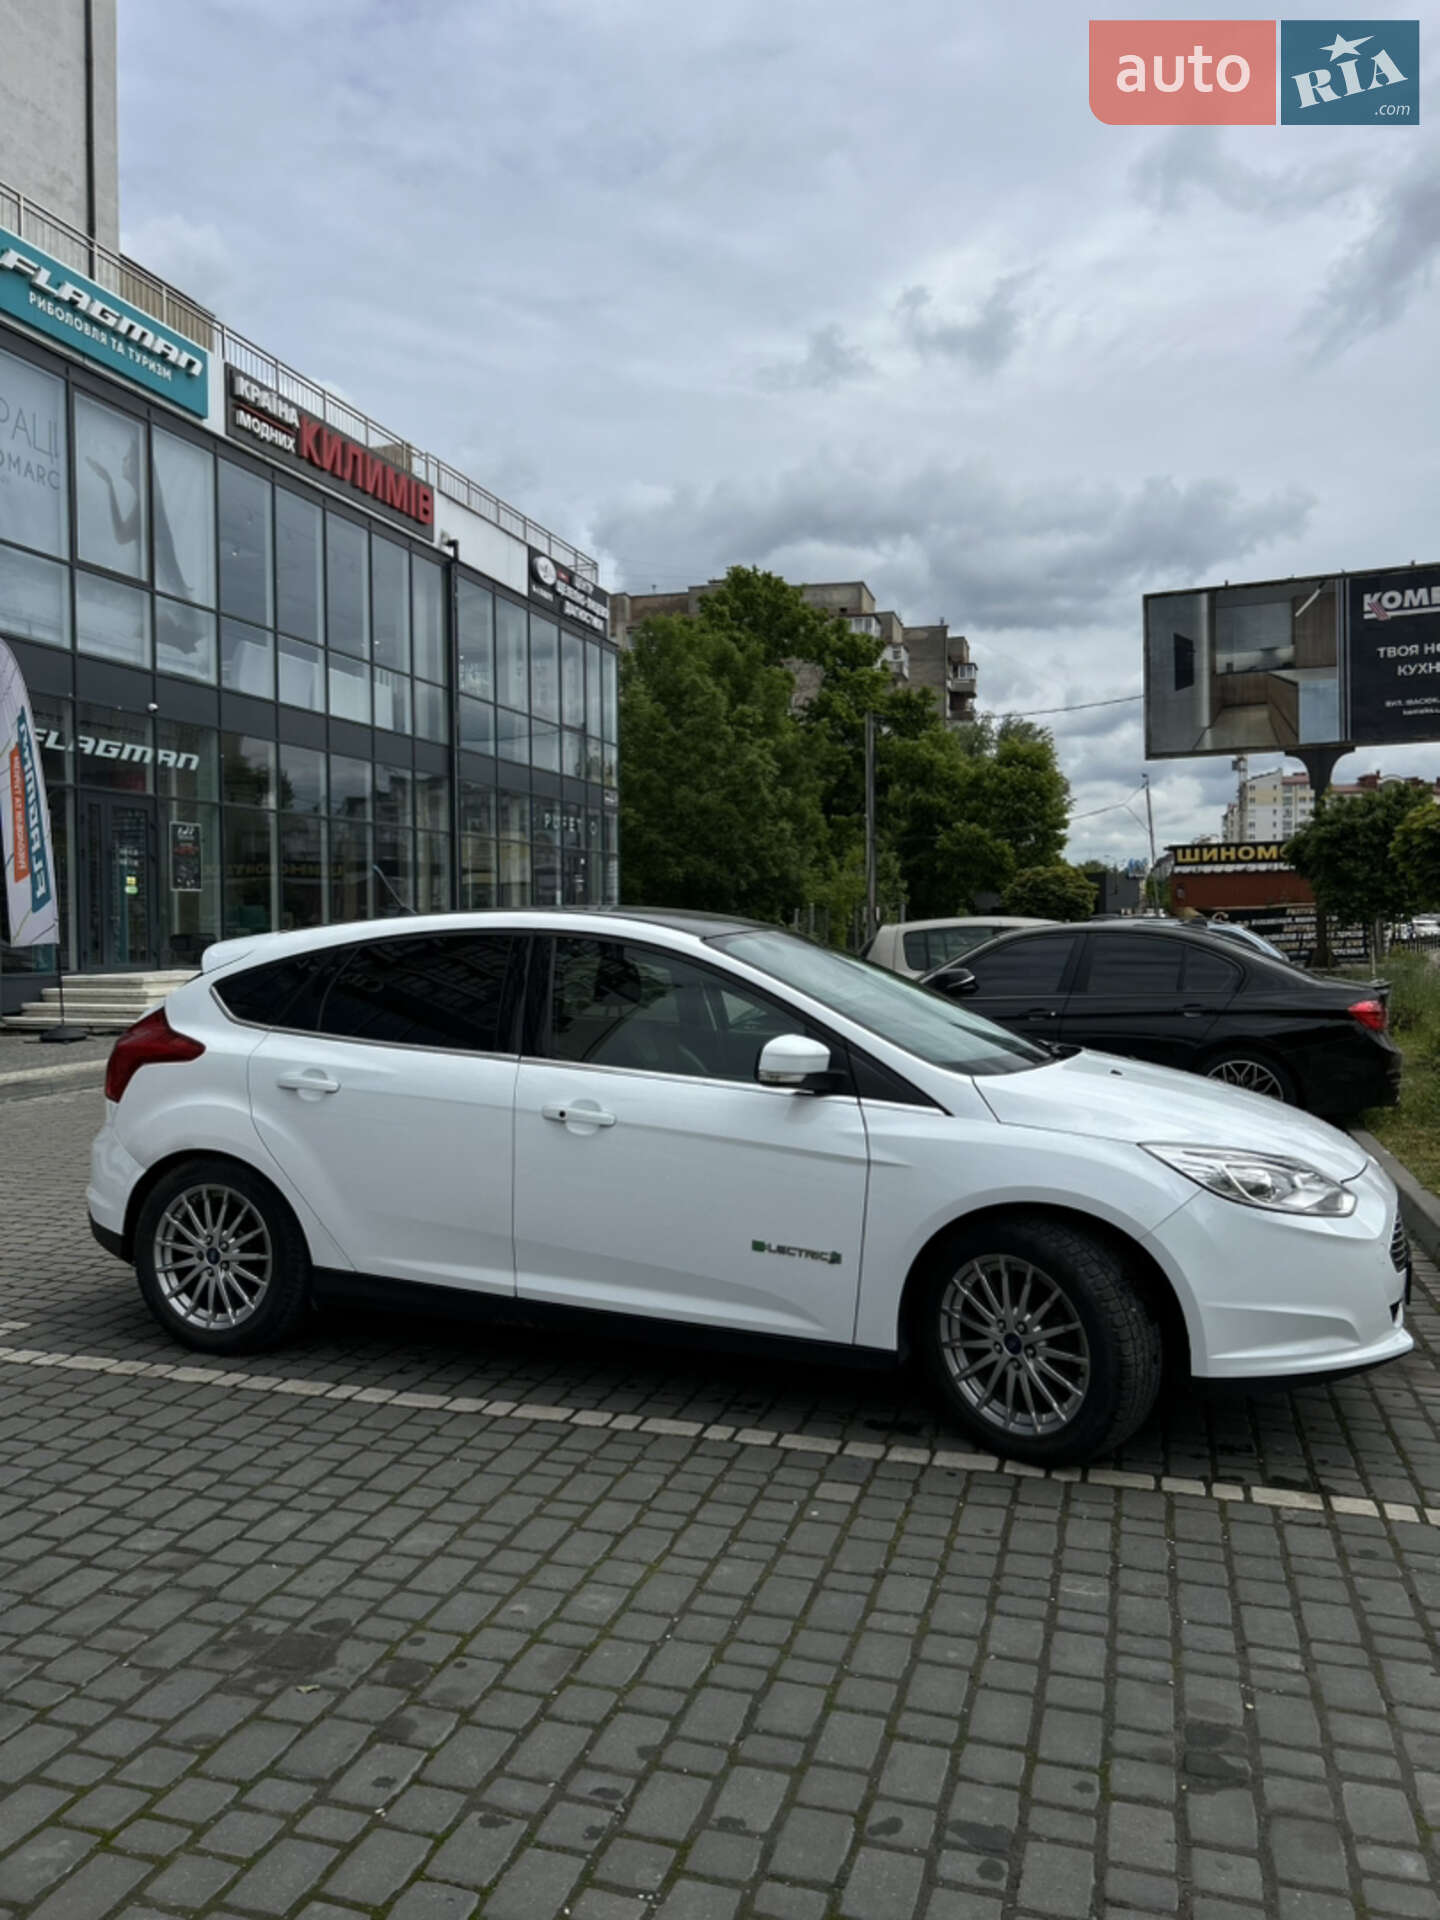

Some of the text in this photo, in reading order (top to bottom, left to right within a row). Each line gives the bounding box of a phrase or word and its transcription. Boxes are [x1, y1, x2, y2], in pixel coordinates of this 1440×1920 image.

[0, 248, 204, 377] FLAGMAN
[28, 291, 173, 382] РИБОЛОВЛЯ ТА ТУРИЗМ
[234, 376, 300, 428] КРАЇНА
[300, 415, 434, 525] КИЛИМІВ
[1376, 644, 1419, 659] ТВОЯ
